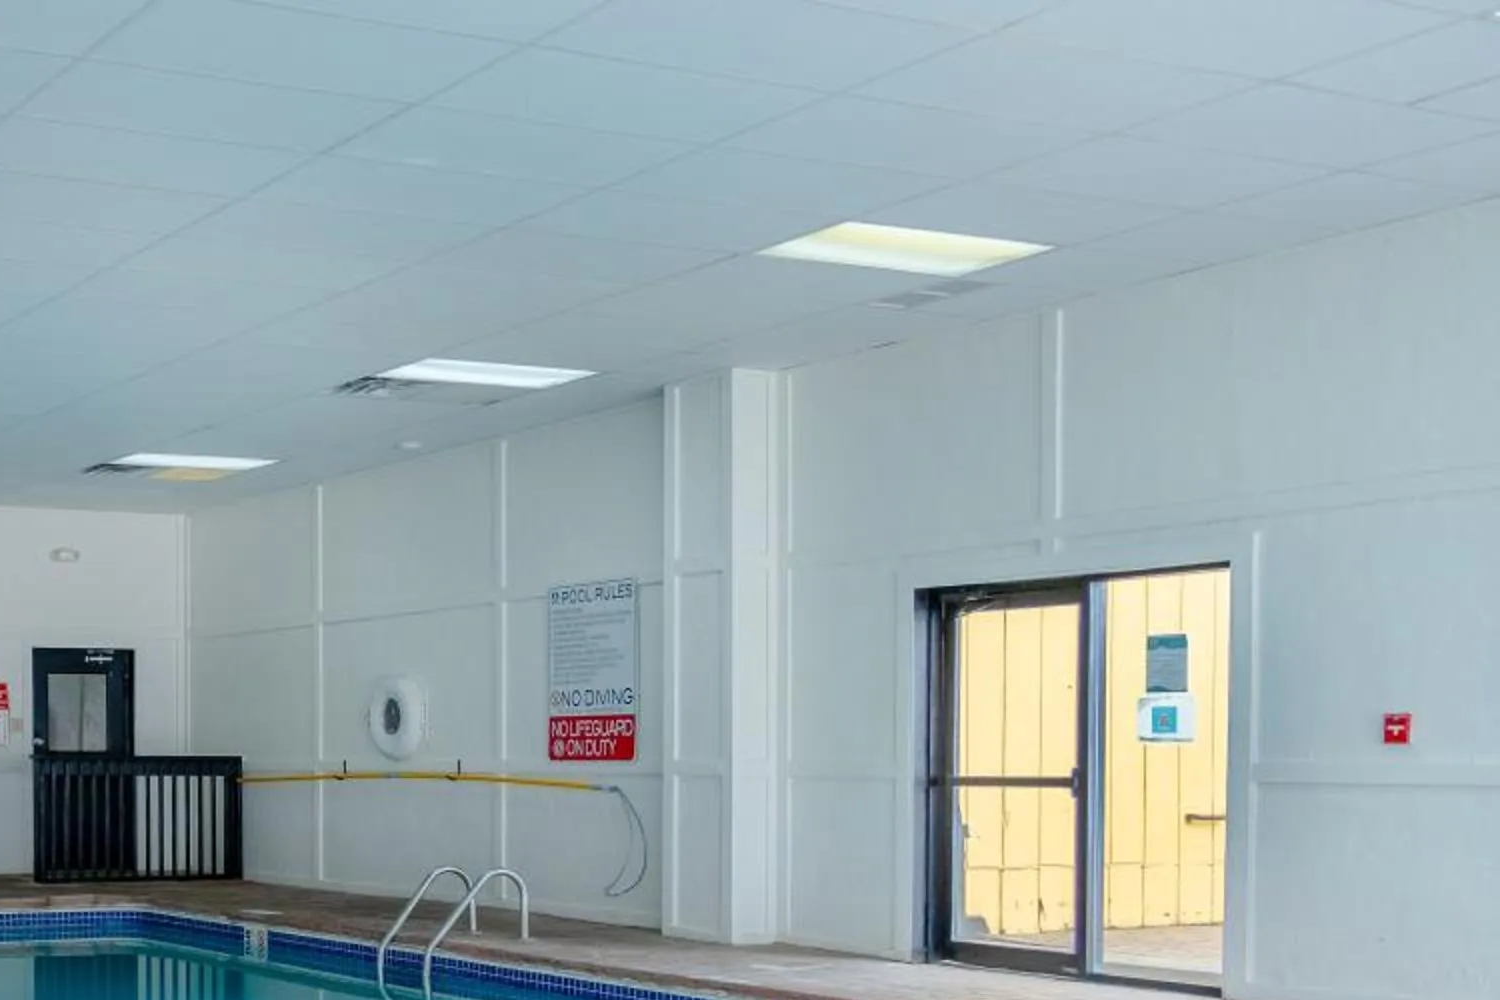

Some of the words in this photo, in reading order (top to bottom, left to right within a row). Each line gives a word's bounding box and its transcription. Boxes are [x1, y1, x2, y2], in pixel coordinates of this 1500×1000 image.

[562, 589, 593, 604] POOL
[596, 583, 632, 600] RULES
[561, 689, 581, 707] NO
[584, 687, 633, 706] DIVING
[551, 720, 569, 737] NO
[569, 719, 633, 737] LIFEGUARD
[566, 739, 584, 756] ON
[585, 738, 617, 757] DUTY
